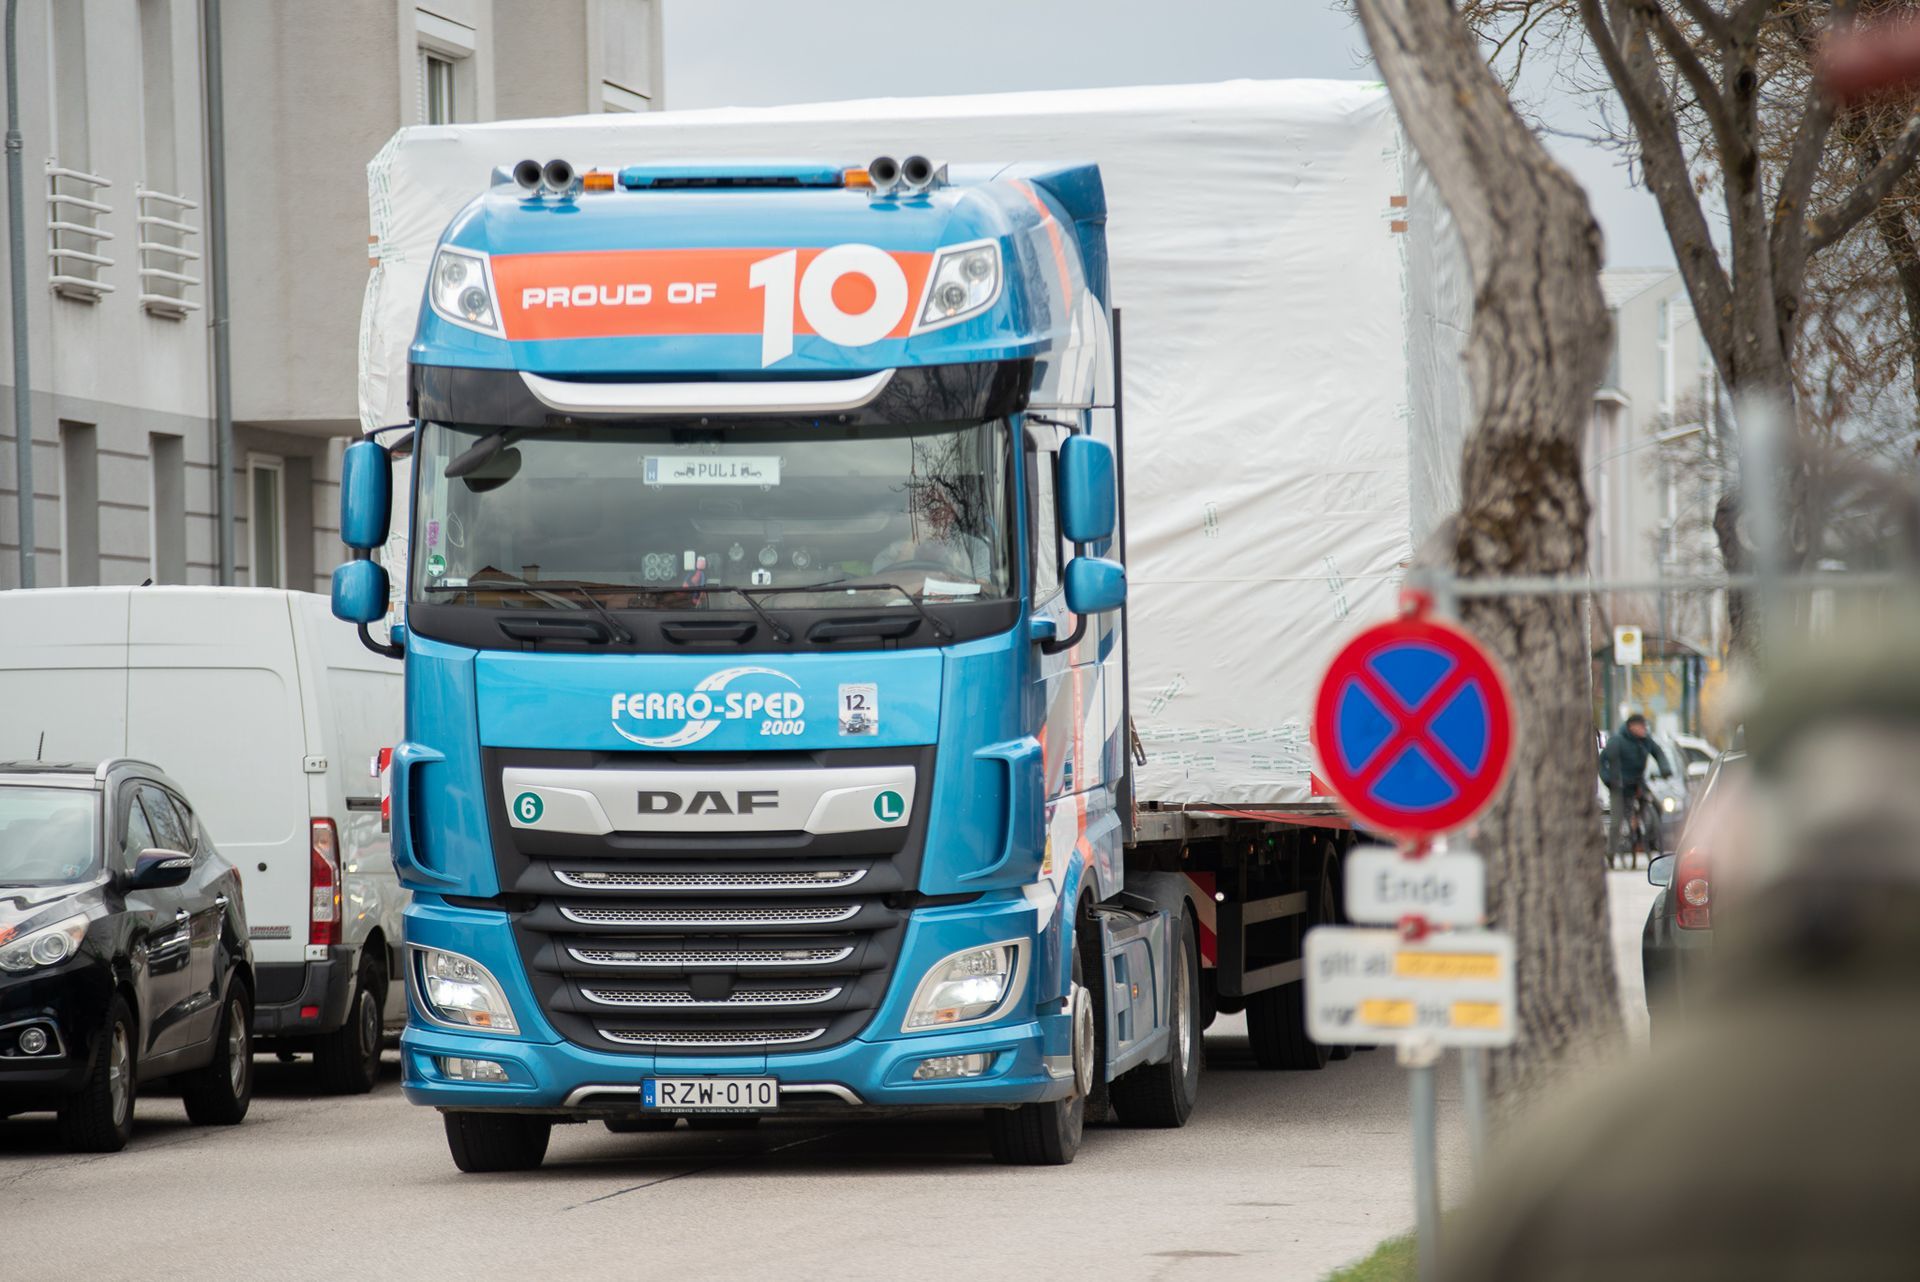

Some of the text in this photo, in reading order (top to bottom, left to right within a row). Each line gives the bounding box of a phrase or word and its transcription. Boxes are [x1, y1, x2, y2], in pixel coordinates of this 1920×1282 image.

[522, 243, 908, 369] PROUD OF 10
[698, 463, 737, 477] PULI
[612, 692, 805, 720] FERRO-SPED
[760, 720, 805, 736] 2000
[521, 797, 536, 819] 6
[637, 790, 779, 815] DAF
[882, 795, 899, 818] L
[1376, 870, 1456, 900] Ende
[646, 1095, 653, 1103] H
[661, 1083, 771, 1104] RZW-010
